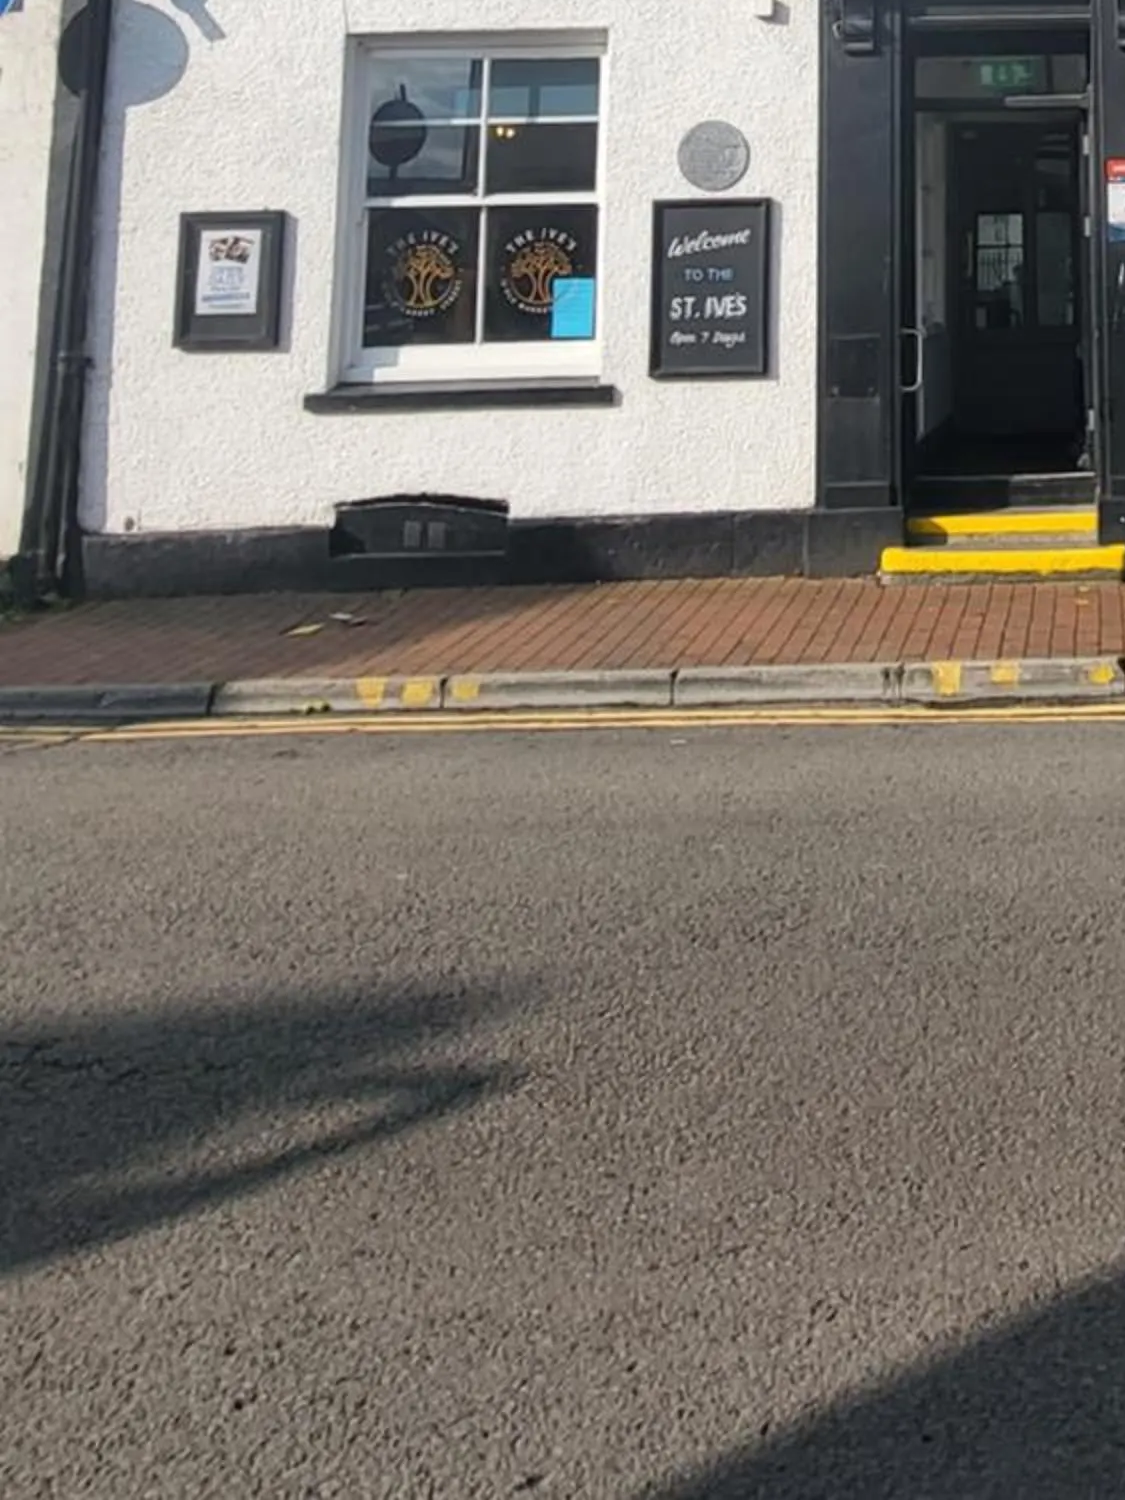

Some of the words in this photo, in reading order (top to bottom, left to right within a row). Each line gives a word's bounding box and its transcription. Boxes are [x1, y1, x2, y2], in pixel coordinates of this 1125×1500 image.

[667, 228, 751, 258] Welcome
[684, 267, 704, 281] TO
[707, 267, 734, 281] THE
